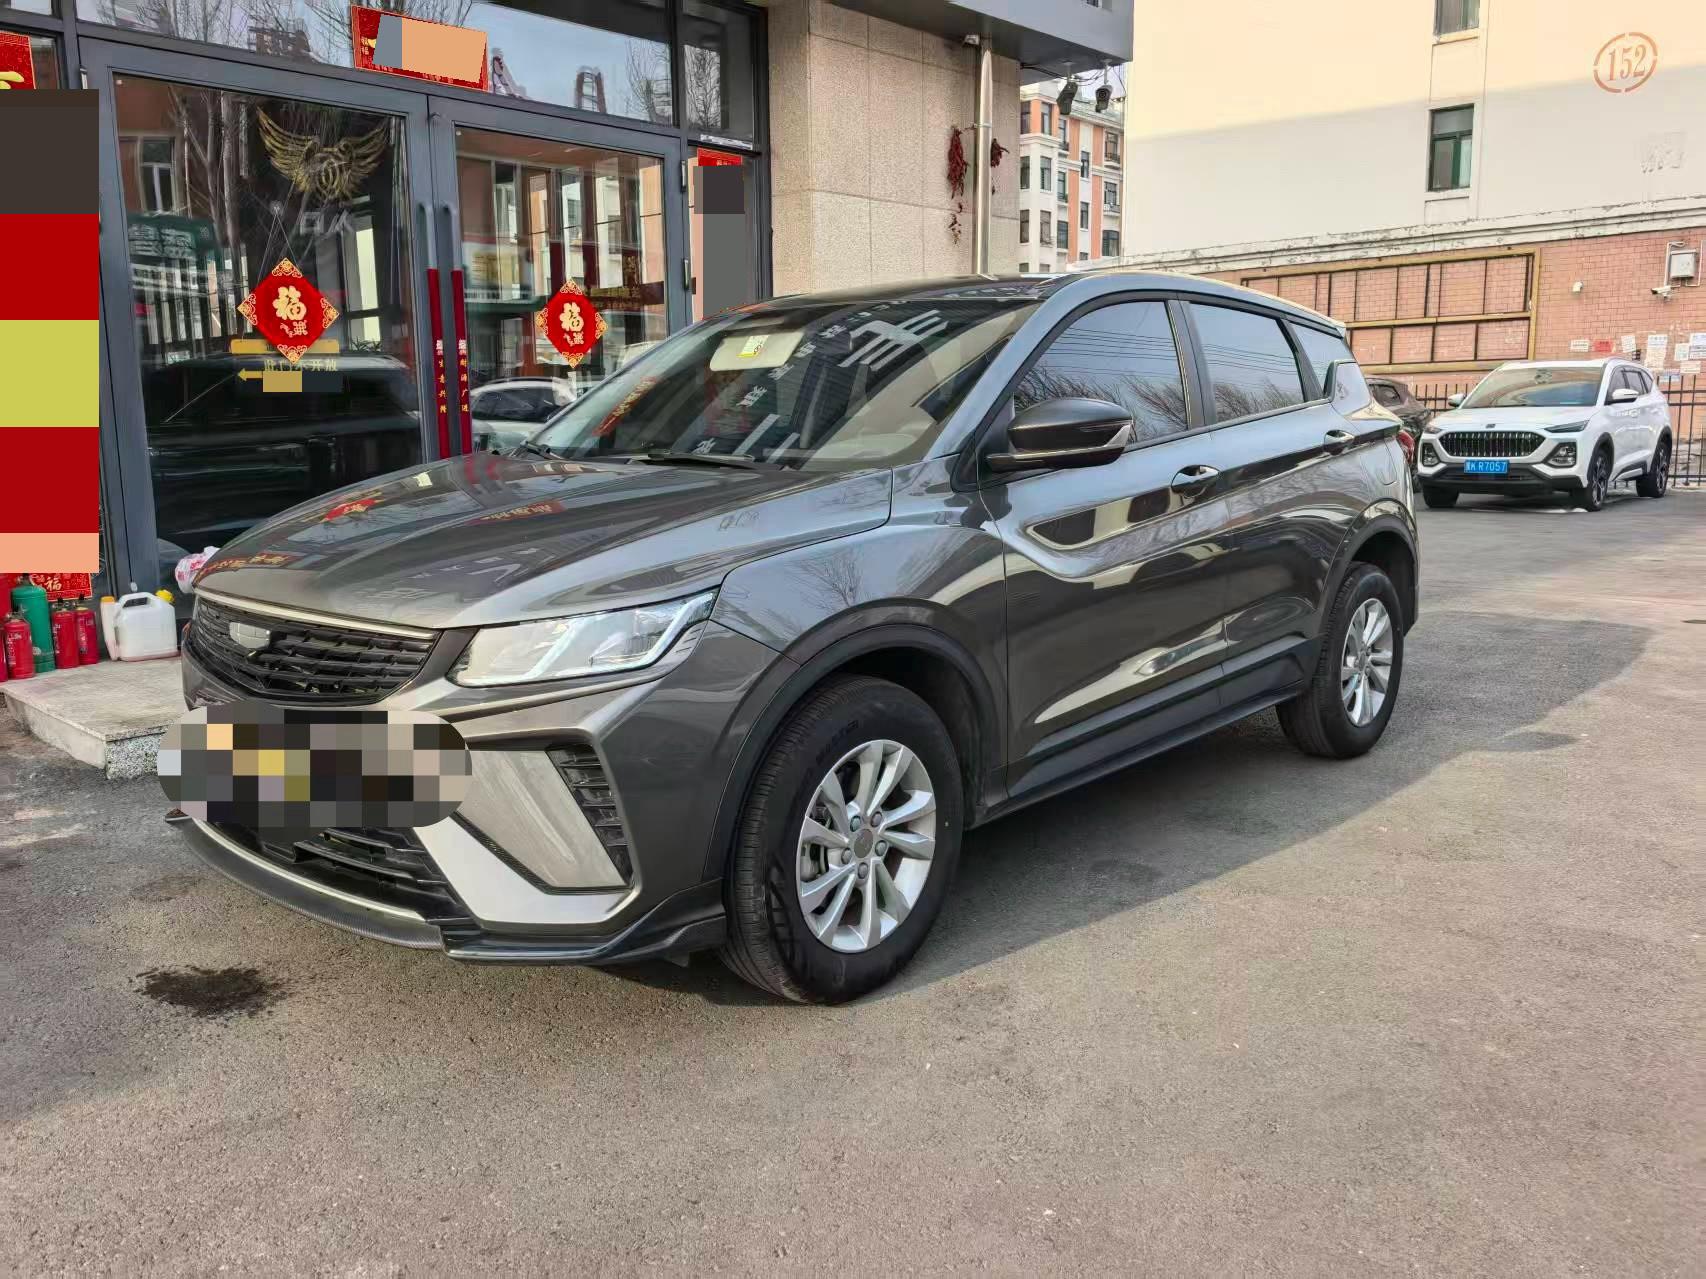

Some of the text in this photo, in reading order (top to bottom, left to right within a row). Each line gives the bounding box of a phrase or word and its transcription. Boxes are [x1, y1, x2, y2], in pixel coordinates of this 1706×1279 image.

[1608, 44, 1646, 81] 152
[272, 285, 307, 321] 福
[559, 301, 585, 332] 福
